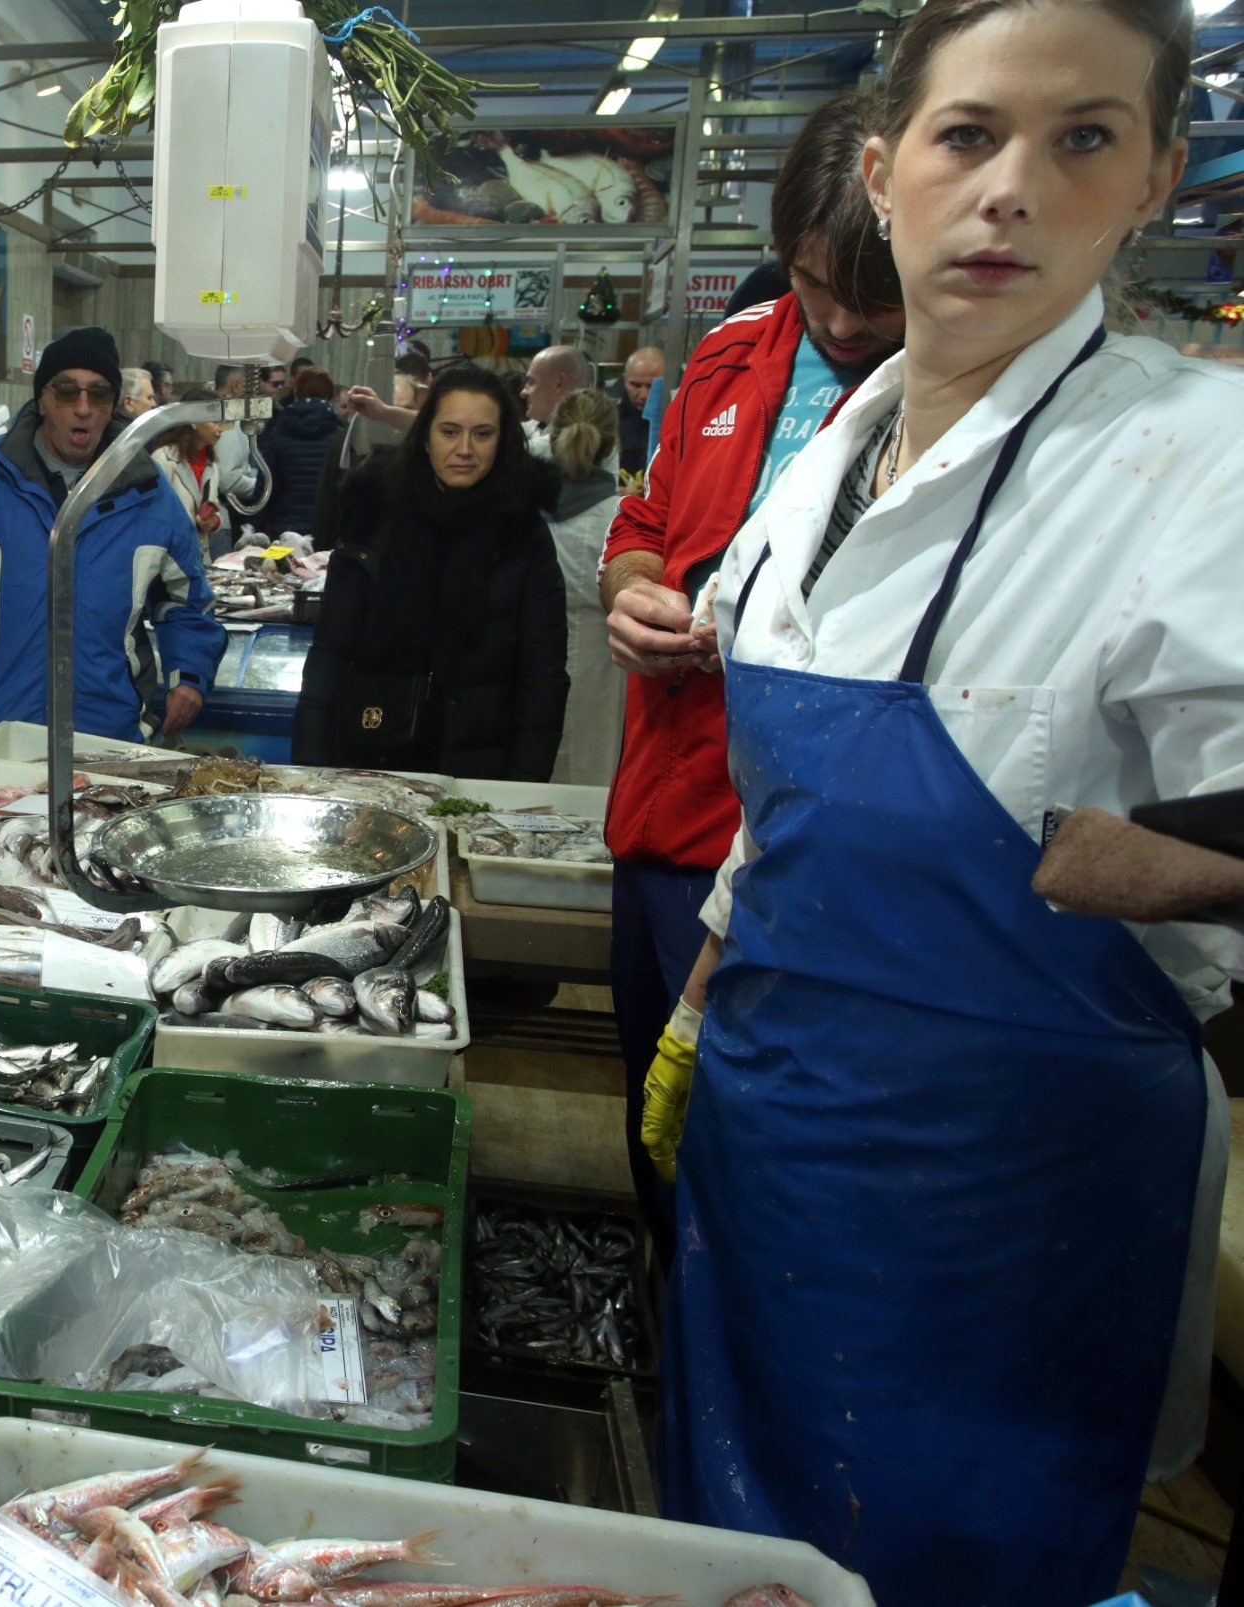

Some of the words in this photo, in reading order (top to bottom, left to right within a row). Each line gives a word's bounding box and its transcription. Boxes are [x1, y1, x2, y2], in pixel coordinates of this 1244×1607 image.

[412, 275, 473, 288] RIBARSKI
[477, 274, 513, 287] OBRT
[701, 423, 735, 437] adidas
